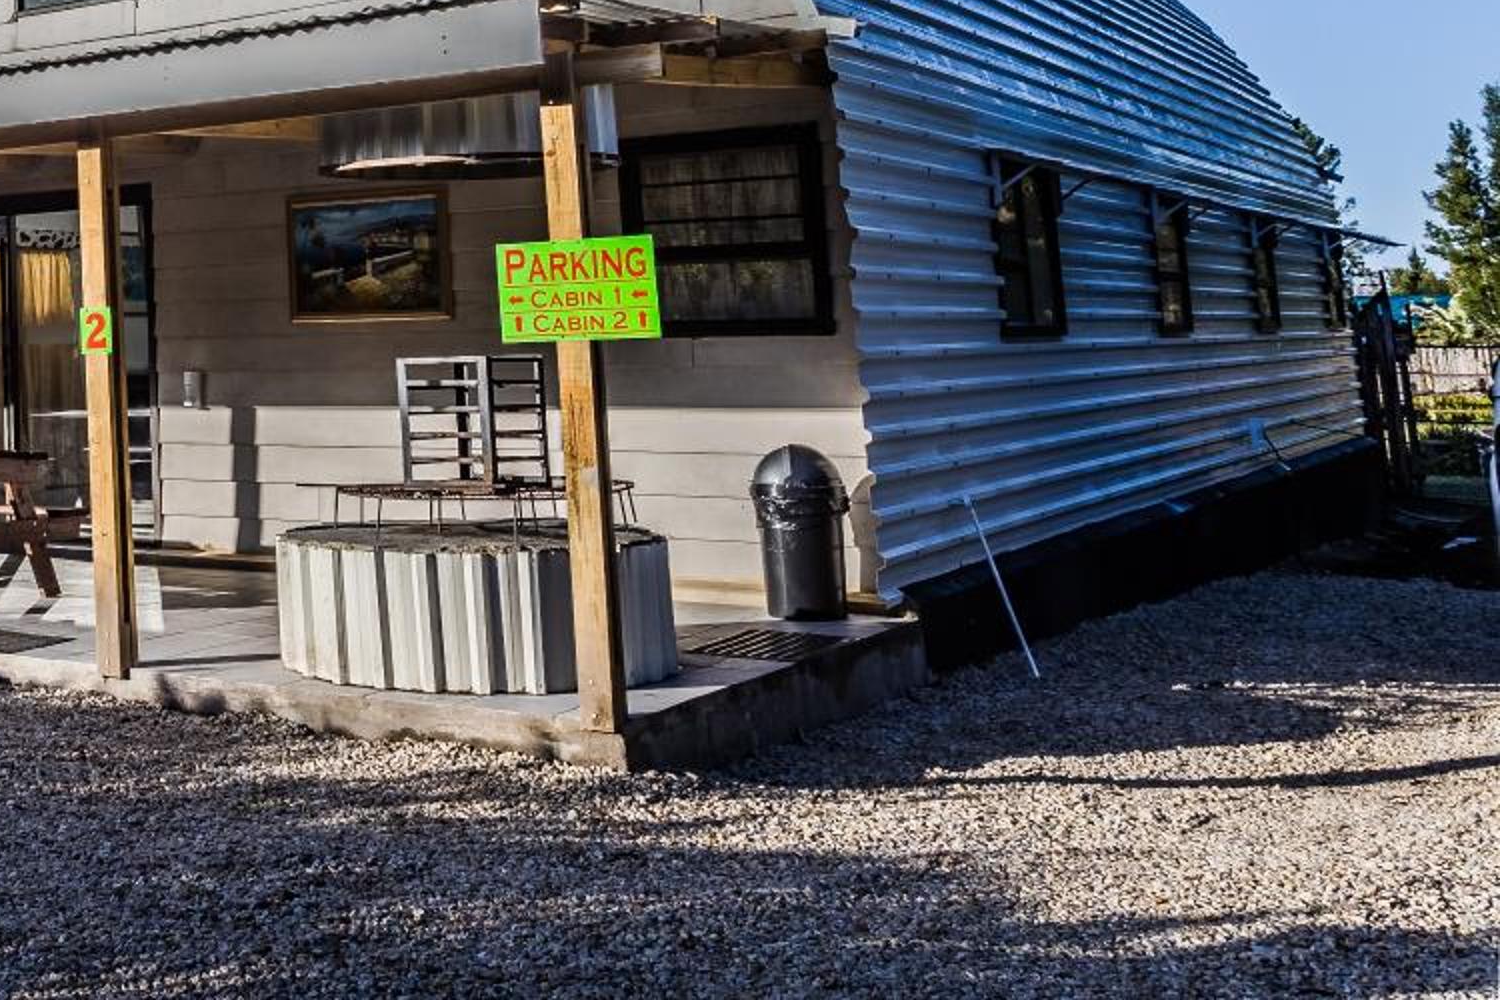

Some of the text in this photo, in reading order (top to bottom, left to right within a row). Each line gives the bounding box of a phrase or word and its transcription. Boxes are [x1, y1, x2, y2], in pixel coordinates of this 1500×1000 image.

[614, 286, 622, 304] 1
[613, 311, 628, 329] 2
[85, 312, 107, 349] 2
